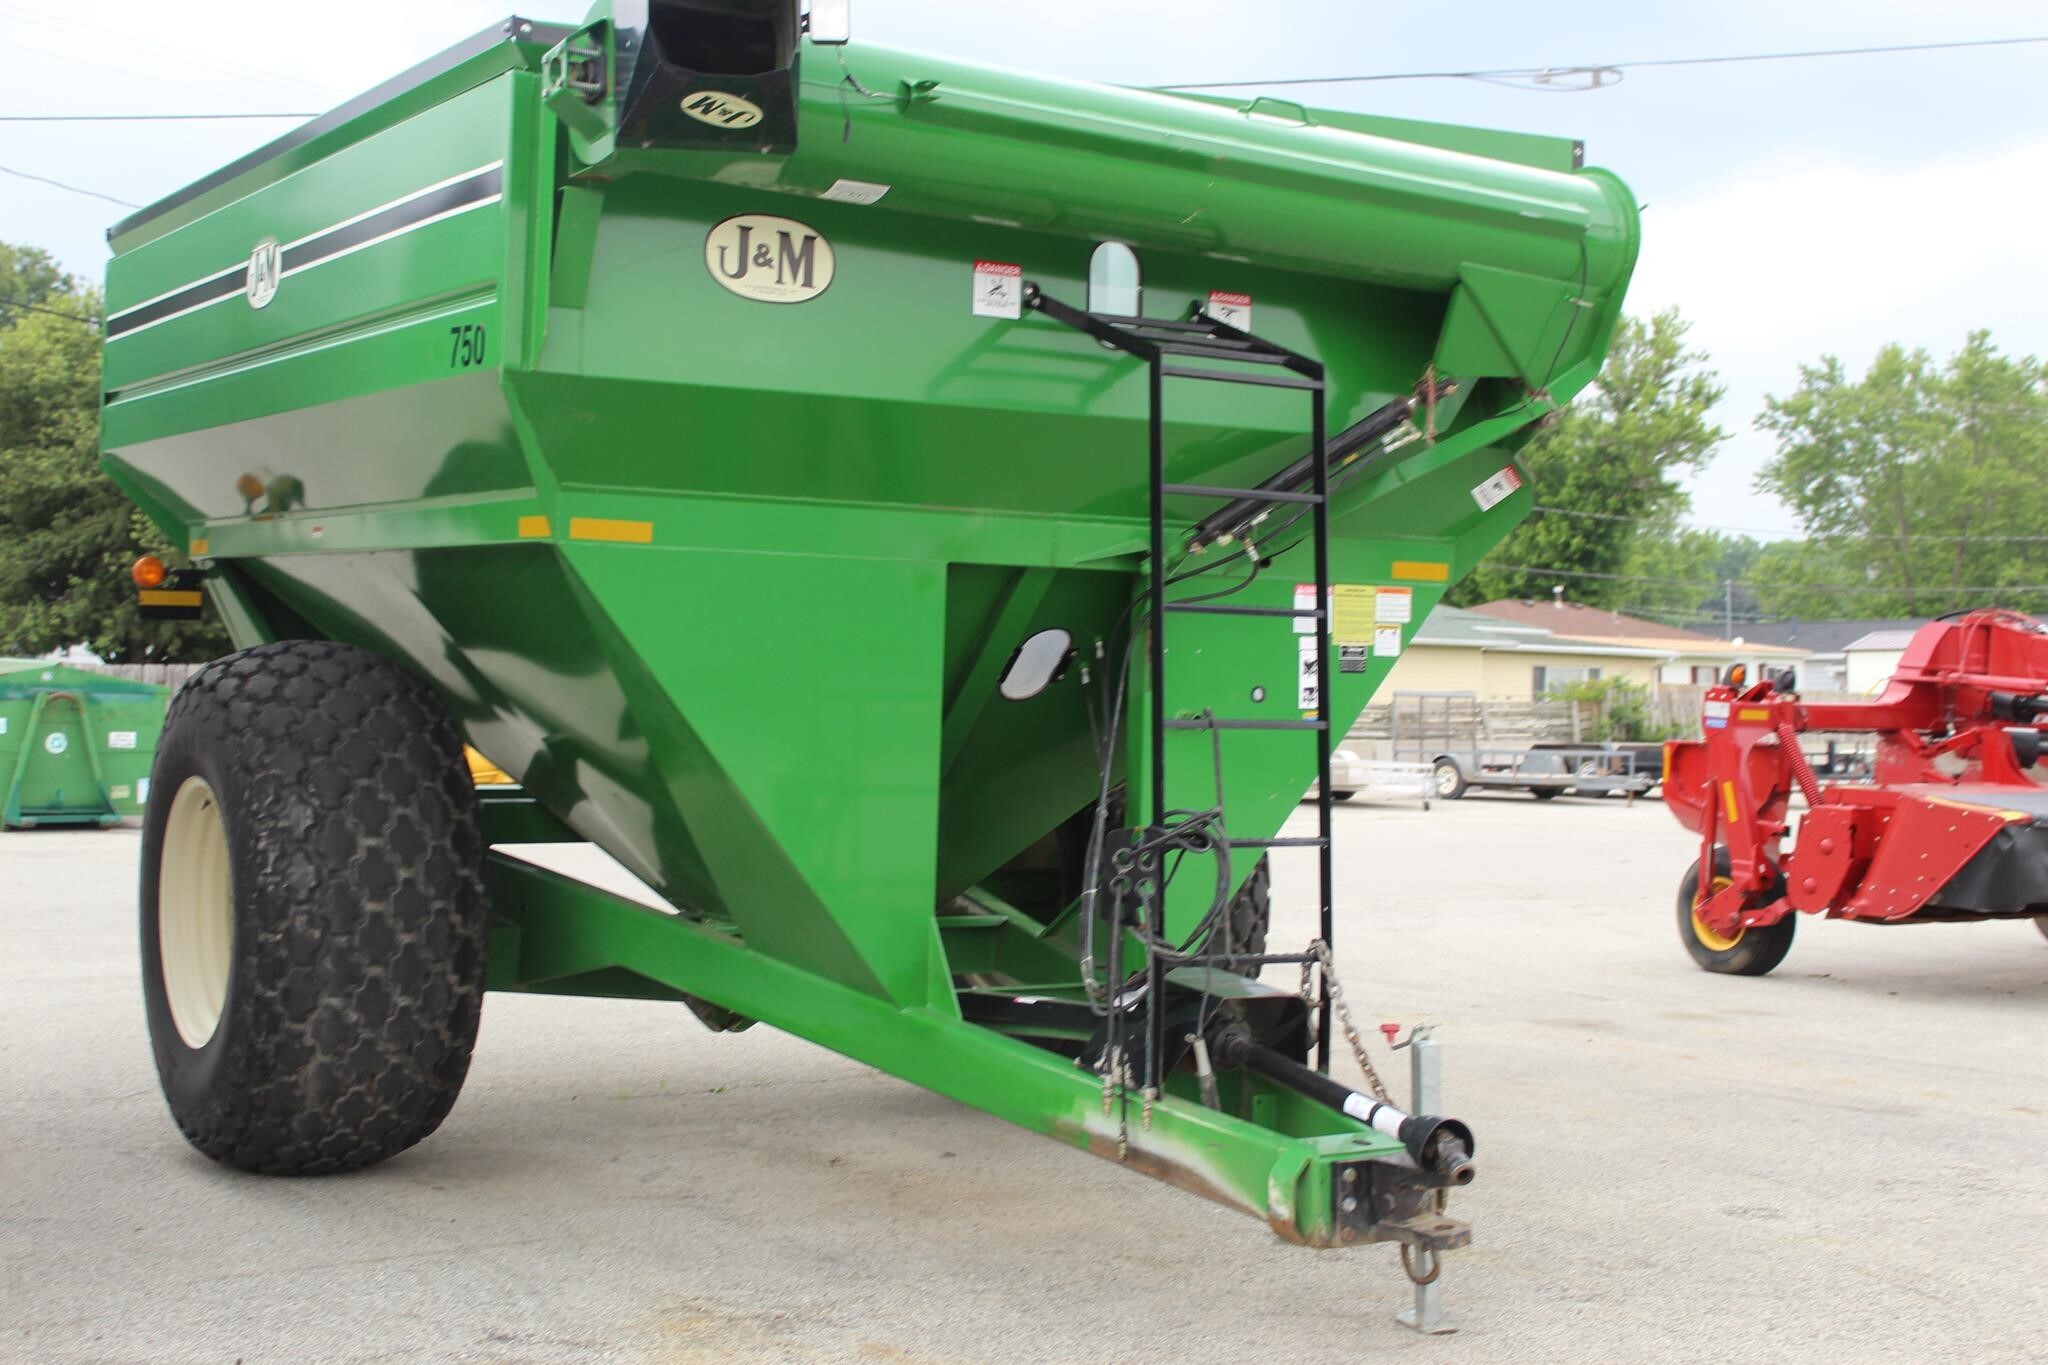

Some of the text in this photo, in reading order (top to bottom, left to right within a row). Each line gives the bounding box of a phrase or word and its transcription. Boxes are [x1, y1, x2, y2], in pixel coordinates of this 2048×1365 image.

[687, 95, 755, 124] J&M
[718, 224, 820, 288] J&M
[451, 325, 486, 369] 750
